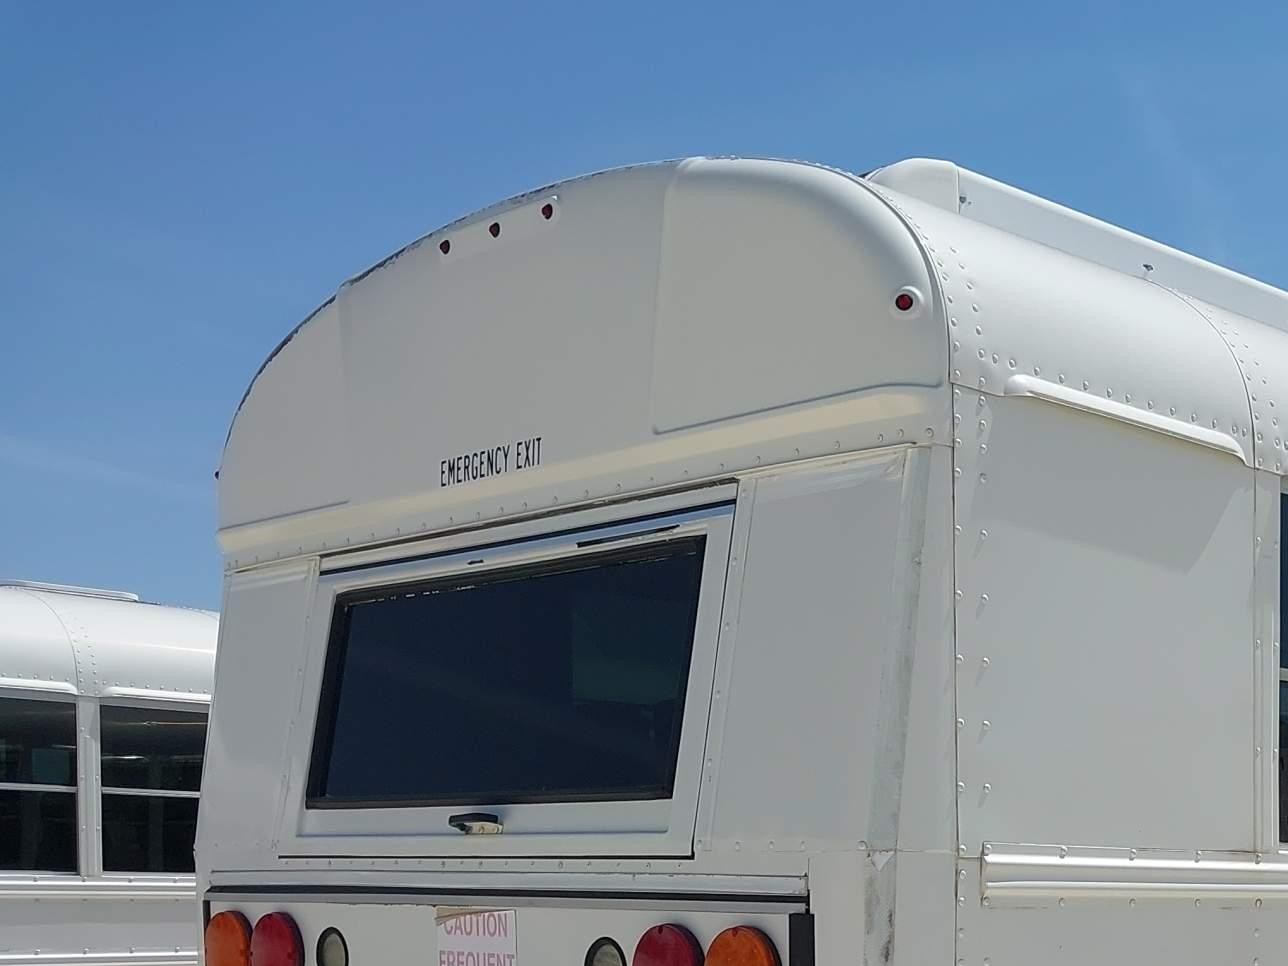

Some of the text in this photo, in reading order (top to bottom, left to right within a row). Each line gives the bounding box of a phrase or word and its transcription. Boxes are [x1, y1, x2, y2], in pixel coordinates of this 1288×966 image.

[441, 437, 542, 487] EMERGENCY EXIT
[443, 912, 508, 938] CAUTION
